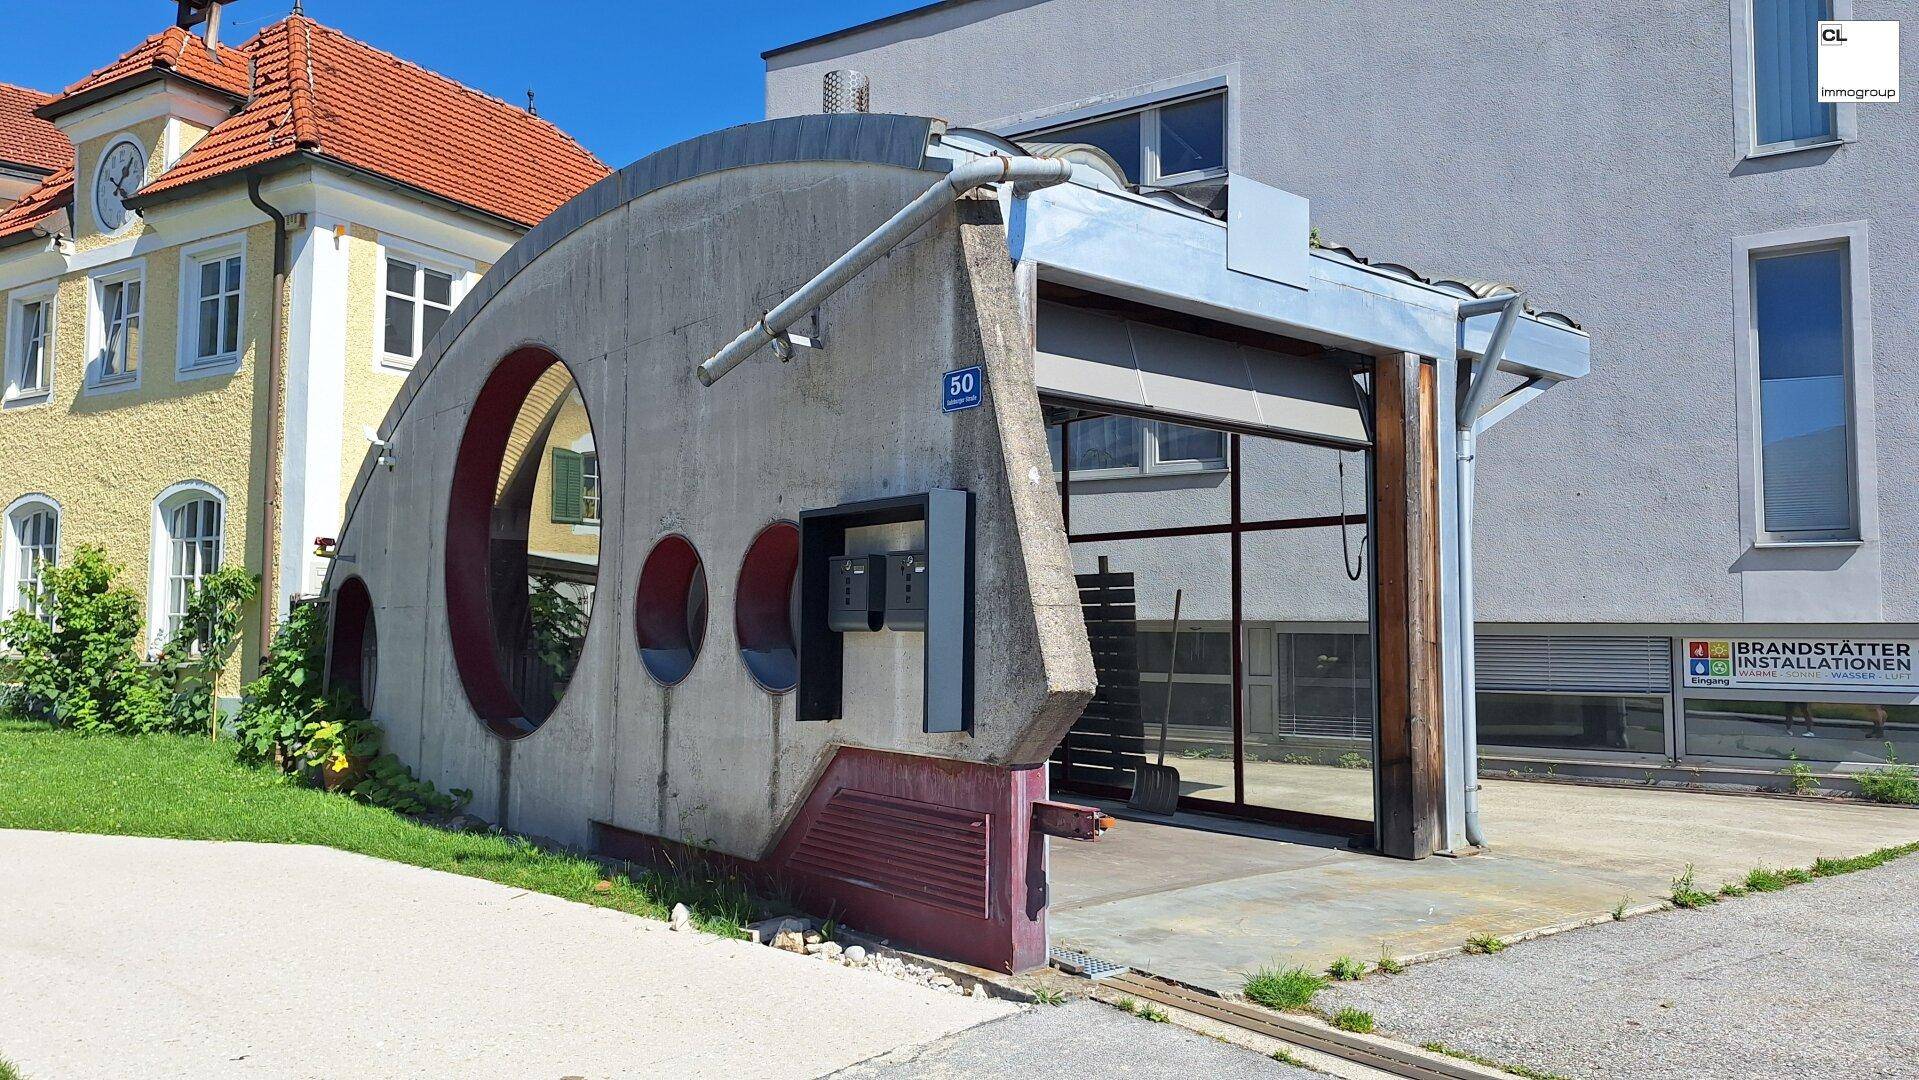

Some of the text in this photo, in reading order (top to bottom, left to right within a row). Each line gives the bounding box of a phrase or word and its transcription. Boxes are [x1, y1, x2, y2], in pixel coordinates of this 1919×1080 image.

[950, 373, 974, 396] 50
[1737, 640, 1911, 656] BRANDSTÄTTER
[1738, 657, 1911, 671] INSTALLATIONEN
[1691, 677, 1730, 686] Eingang
[1785, 671, 1821, 679] SONNE
[1831, 672, 1876, 680] WASSER
